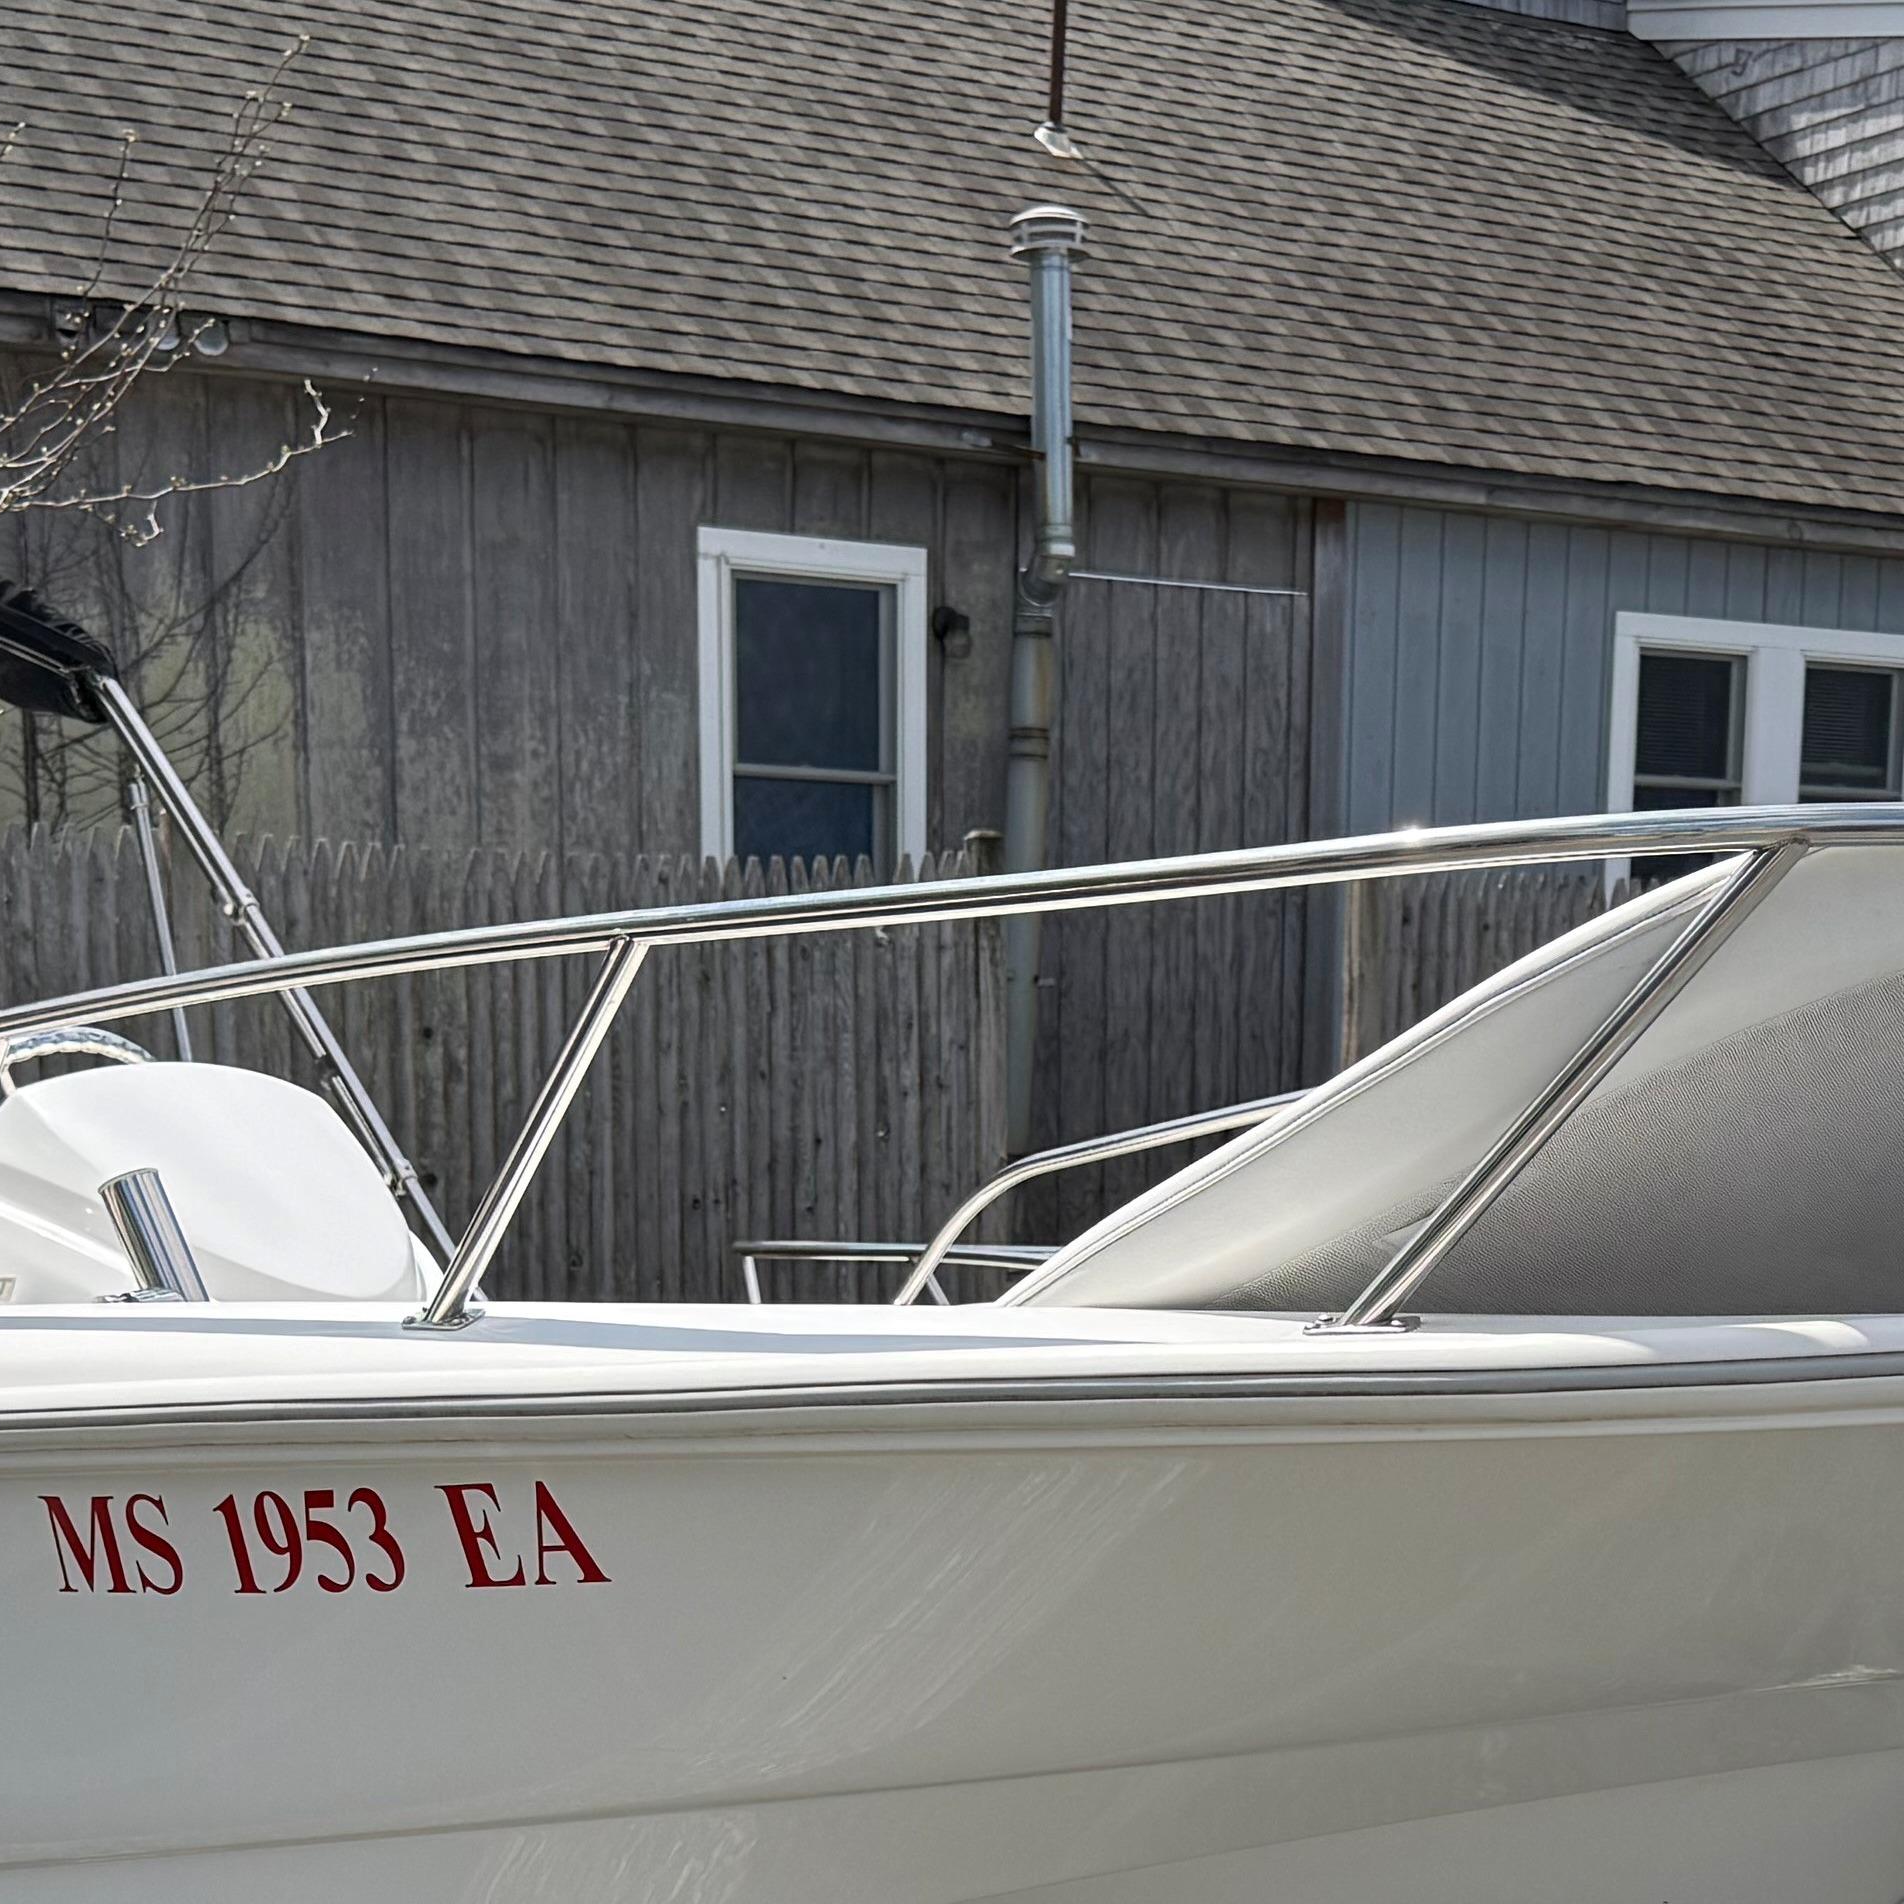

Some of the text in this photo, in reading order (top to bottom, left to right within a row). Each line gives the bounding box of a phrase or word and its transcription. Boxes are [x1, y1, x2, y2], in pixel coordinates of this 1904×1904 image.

[37, 1480, 613, 1595] MS 1953 EA
